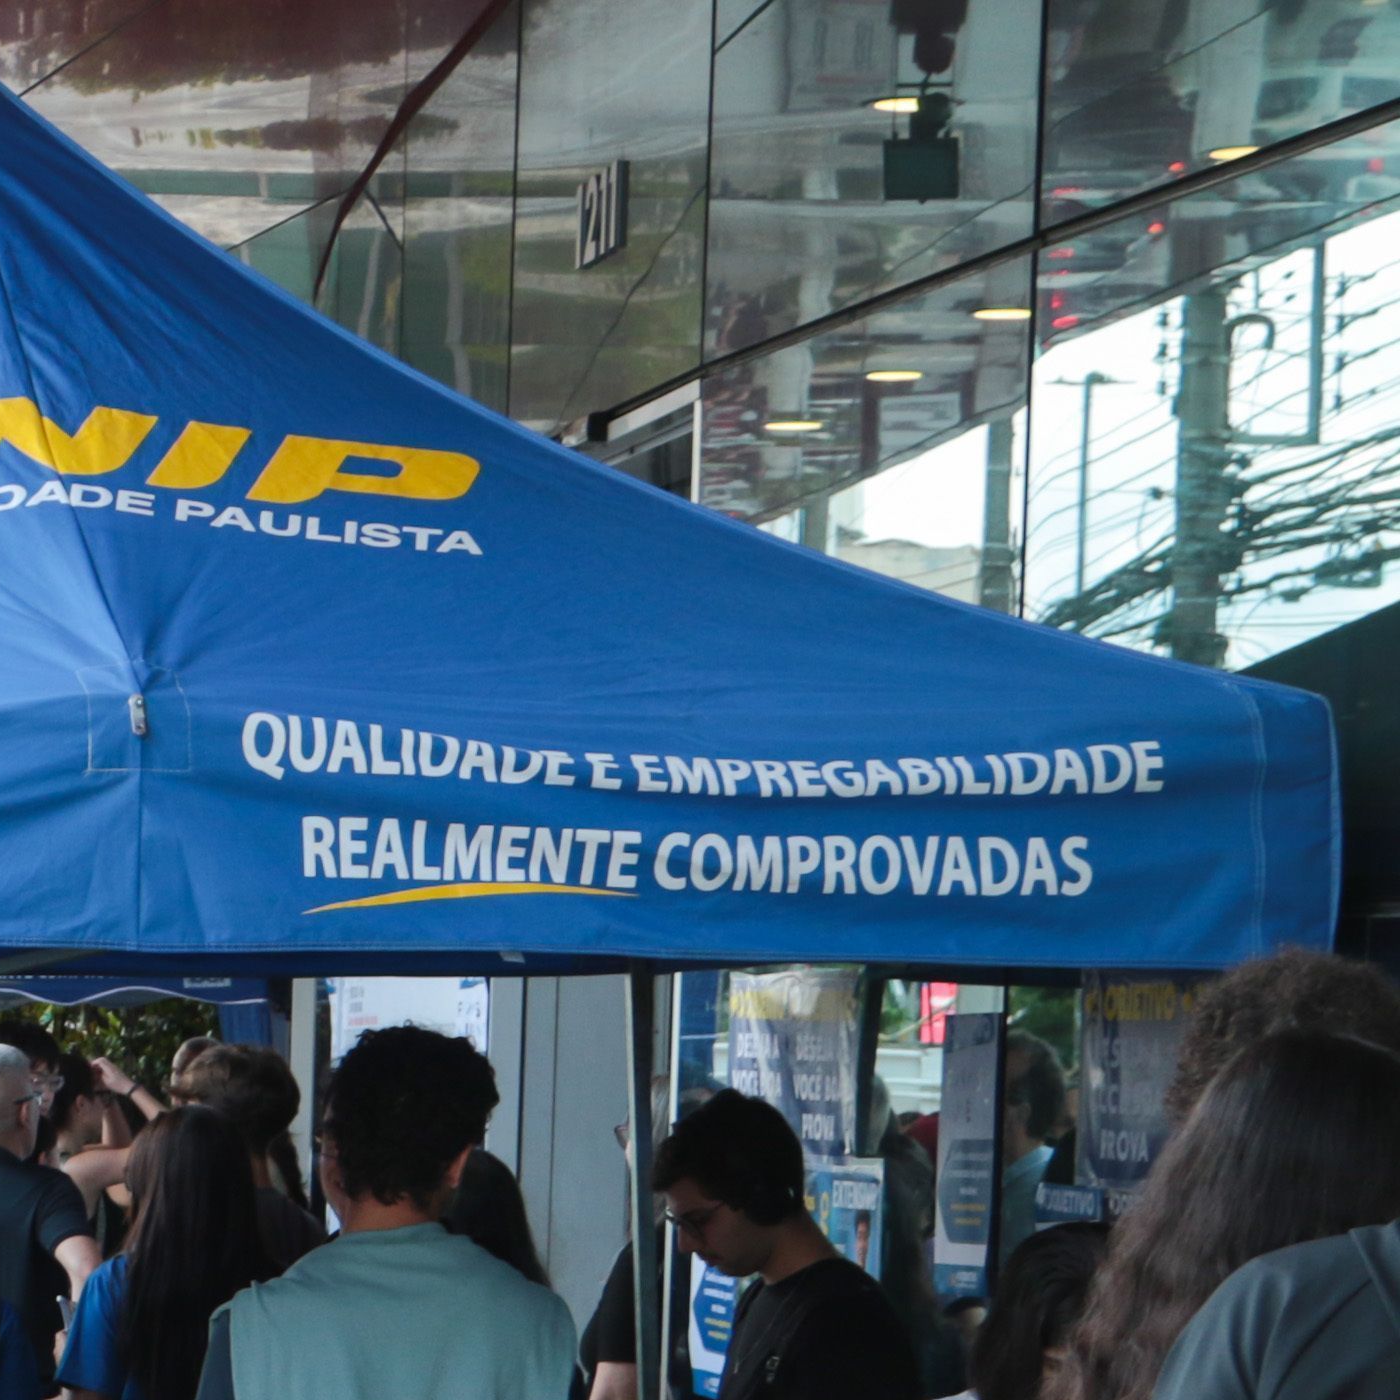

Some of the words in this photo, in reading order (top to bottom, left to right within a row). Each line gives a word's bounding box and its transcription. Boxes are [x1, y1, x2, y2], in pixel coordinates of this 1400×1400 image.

[575, 160, 618, 270] 1211
[174, 499, 483, 555] PAULISTA
[240, 711, 576, 787] QUALIDADE
[587, 751, 627, 790] E
[632, 740, 1165, 798] EMPREGABILIDADE
[301, 815, 643, 890] REALMENTE
[653, 831, 1093, 897] COMPROVADAS
[1100, 1128, 1149, 1163] PROVA
